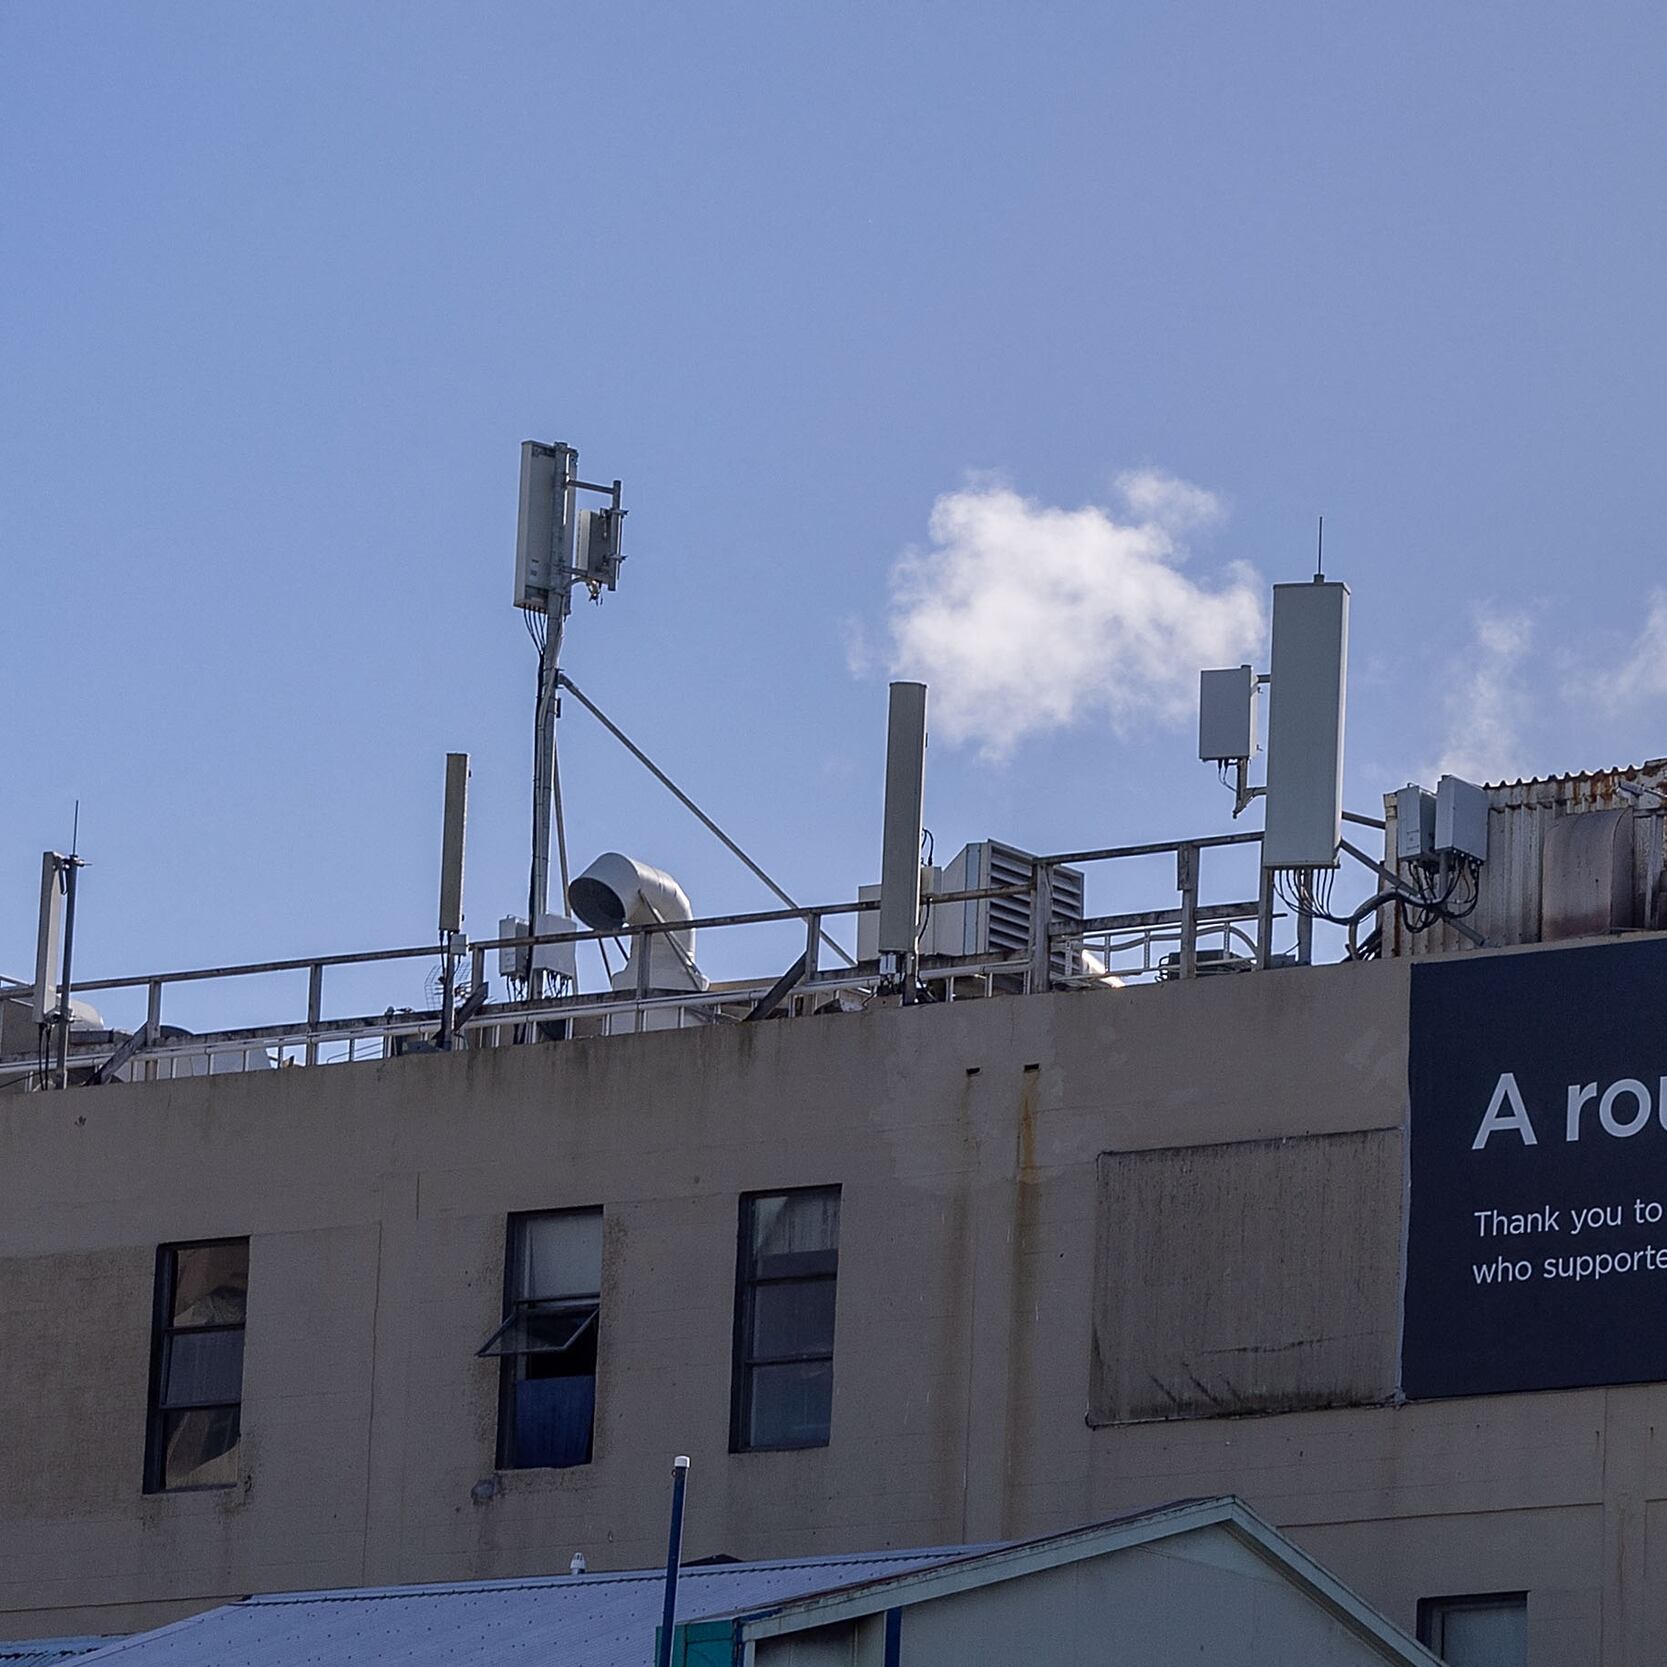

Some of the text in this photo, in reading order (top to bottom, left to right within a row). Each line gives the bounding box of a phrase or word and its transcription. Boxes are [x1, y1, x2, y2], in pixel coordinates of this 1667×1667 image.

[1471, 1072, 1538, 1150] A
[1474, 1206, 1560, 1237] Thank
[1570, 1204, 1623, 1235] you
[1634, 1199, 1663, 1224] to
[1473, 1256, 1533, 1284] who
